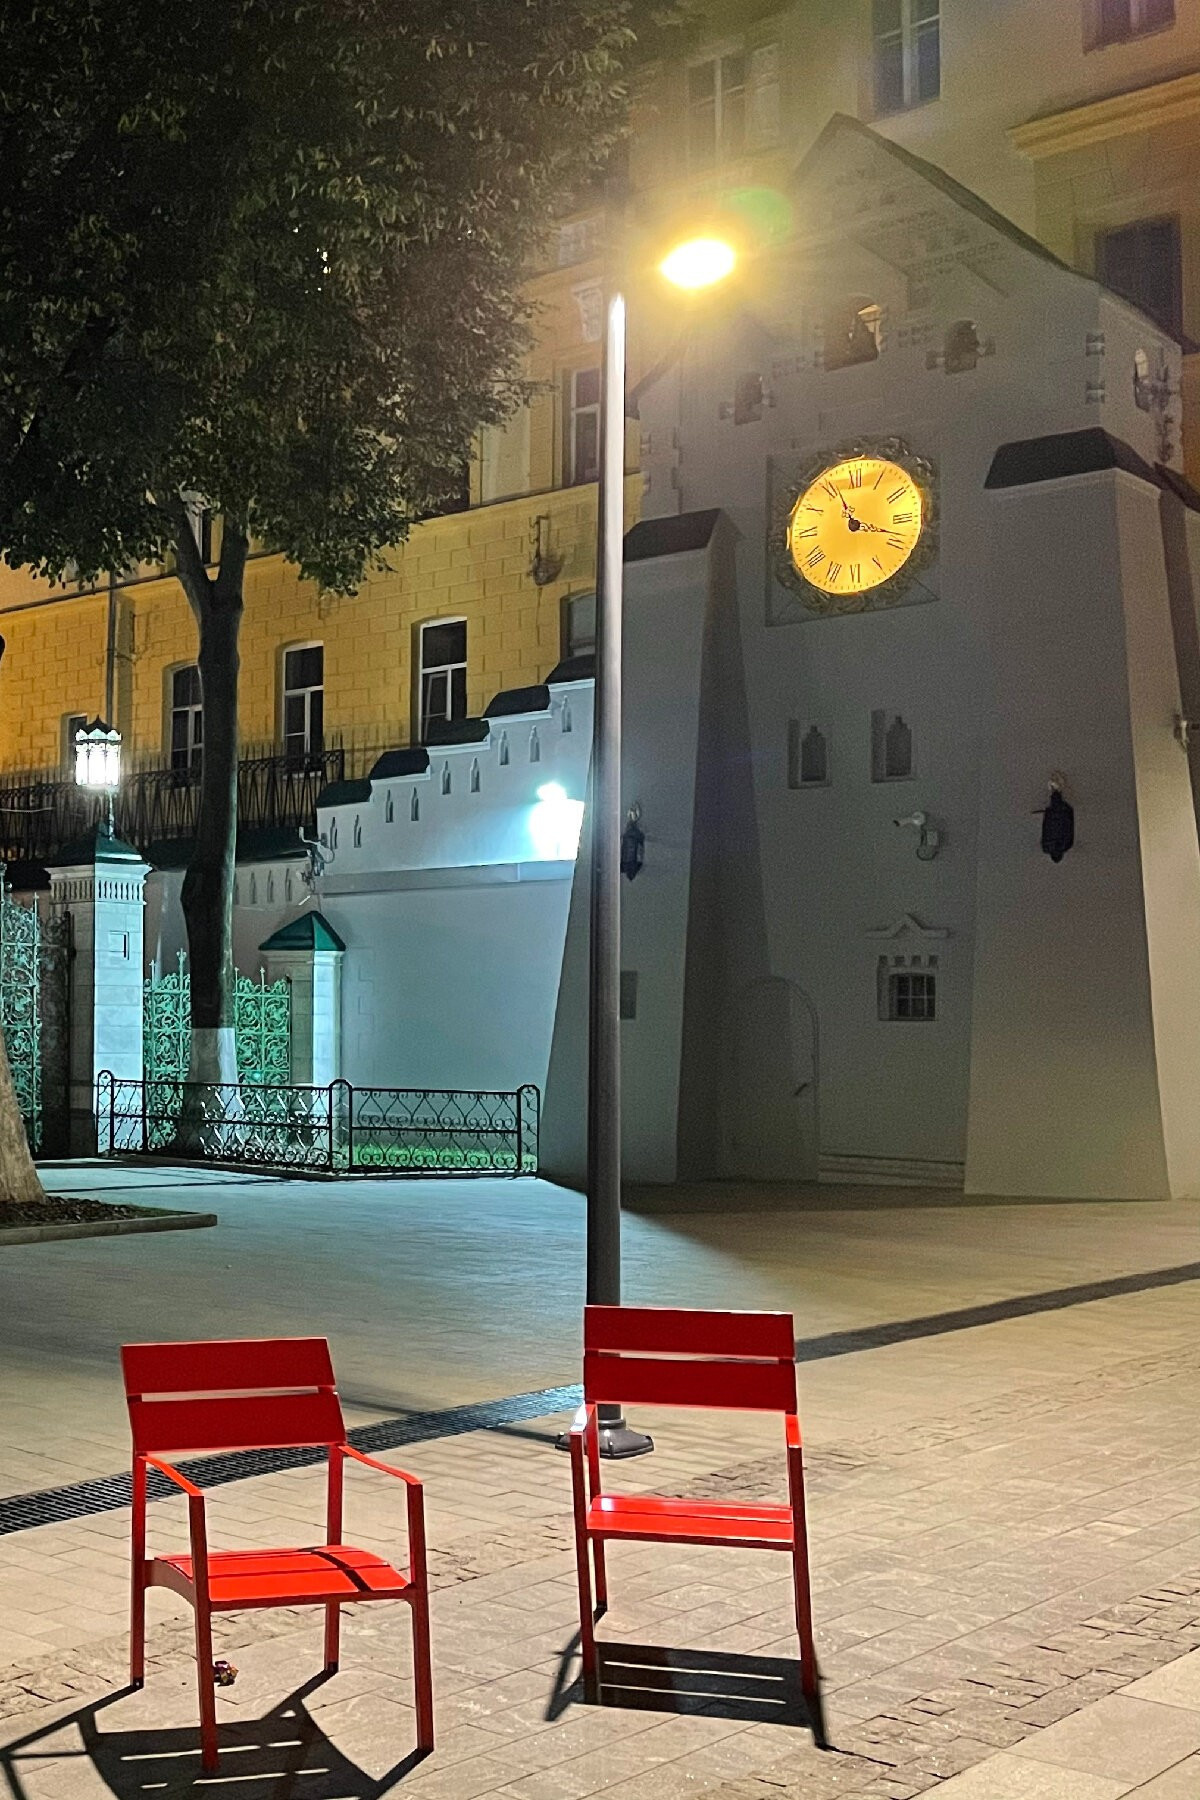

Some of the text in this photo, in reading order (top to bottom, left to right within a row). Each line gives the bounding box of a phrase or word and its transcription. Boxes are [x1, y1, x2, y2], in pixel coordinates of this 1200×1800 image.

[849, 468, 862, 490] XII
[886, 486, 907, 504] II
[893, 512, 913, 525] III
[825, 561, 842, 584] VII
[850, 563, 861, 584] VI
